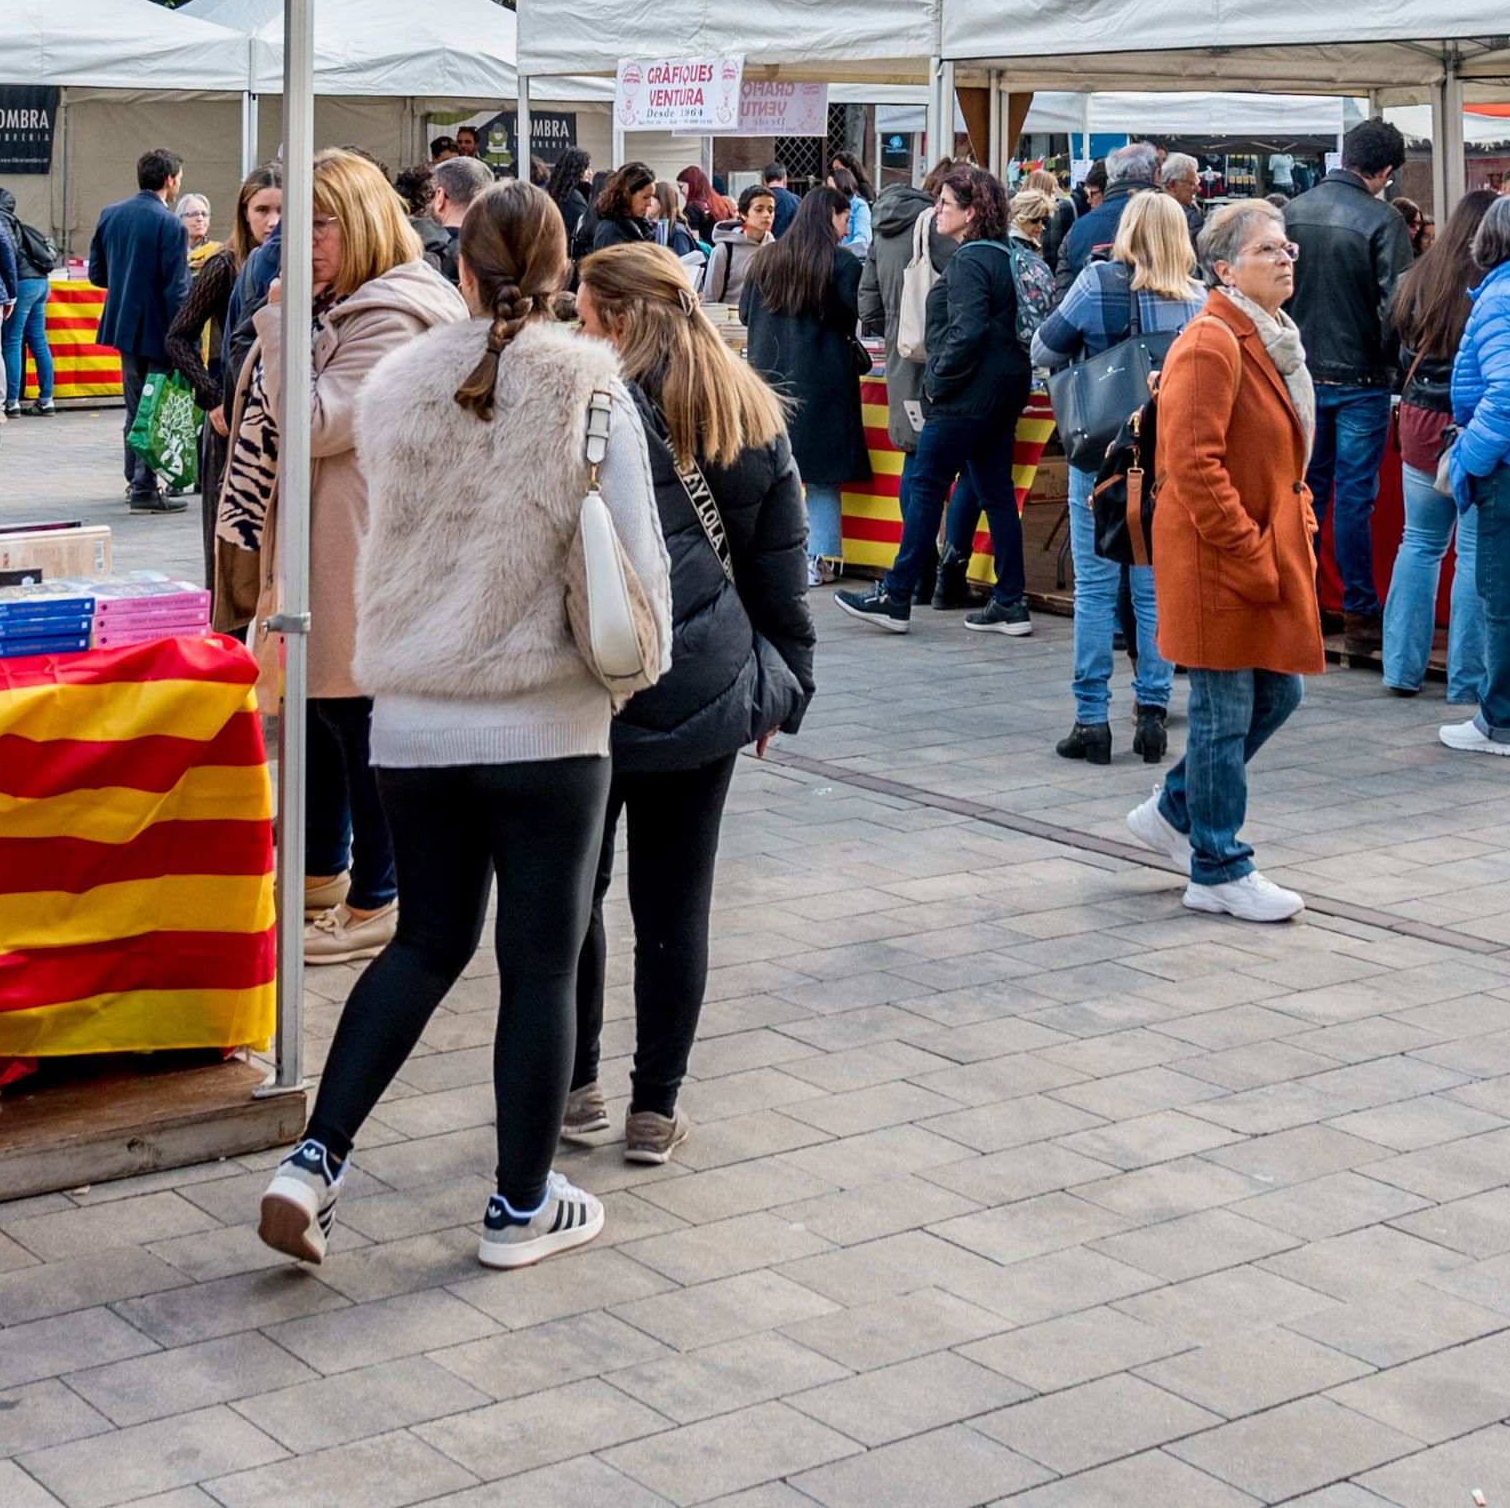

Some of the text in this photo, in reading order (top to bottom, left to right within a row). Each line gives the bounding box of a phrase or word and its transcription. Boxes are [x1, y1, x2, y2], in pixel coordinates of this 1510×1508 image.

[647, 62, 714, 86] GRÀFIQUES
[649, 88, 704, 107] VENTURA
[647, 108, 704, 118] Desde 1964
[513, 118, 569, 137] LMBRA
